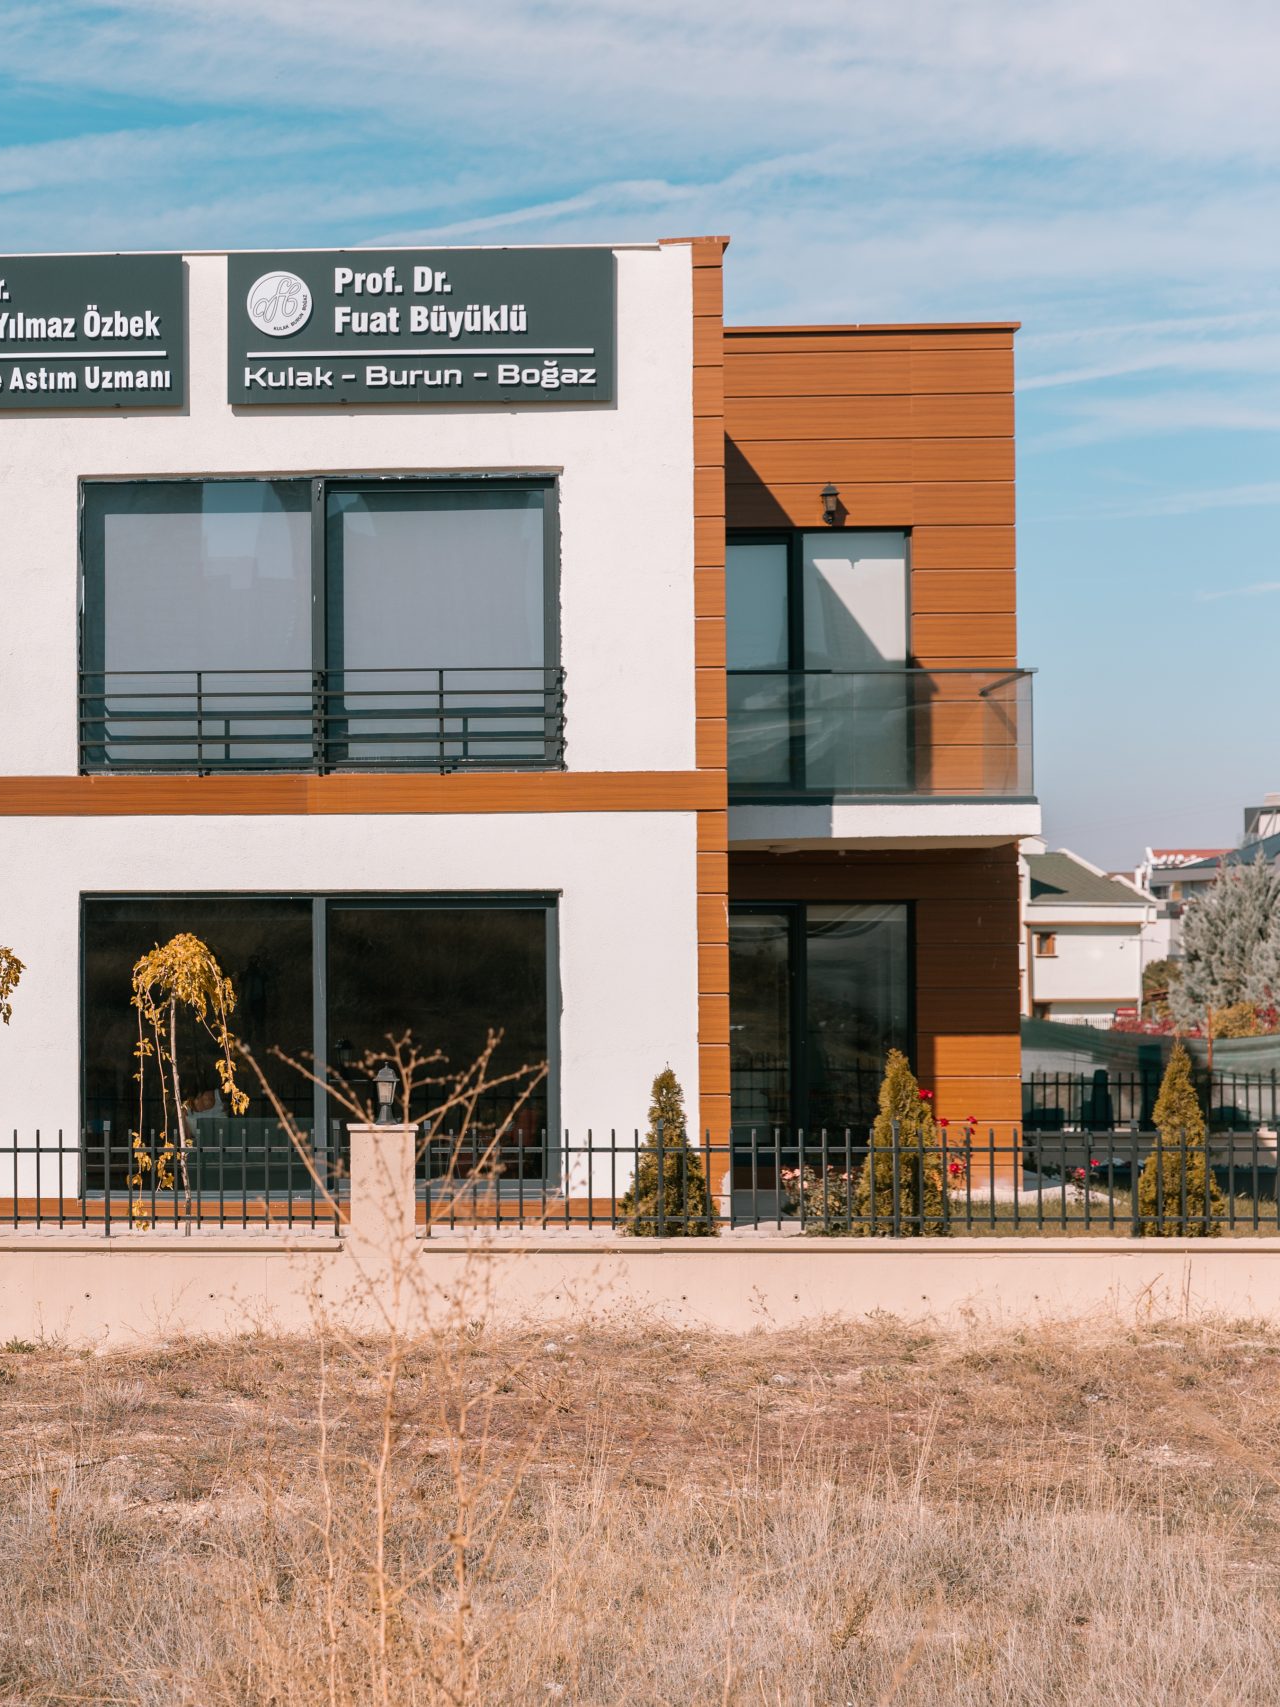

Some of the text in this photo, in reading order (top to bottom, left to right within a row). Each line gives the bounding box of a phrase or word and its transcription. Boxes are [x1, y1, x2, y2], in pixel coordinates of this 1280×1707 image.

[334, 266, 452, 294] Prof. Dr.
[83, 304, 161, 338] Özbek
[334, 304, 528, 338] Fuat Büyüklü
[9, 367, 77, 391] Astım
[84, 366, 171, 390] Uzmanı
[244, 366, 333, 388] Kulak
[365, 365, 462, 387] Burun
[497, 360, 597, 388] Boğaz
